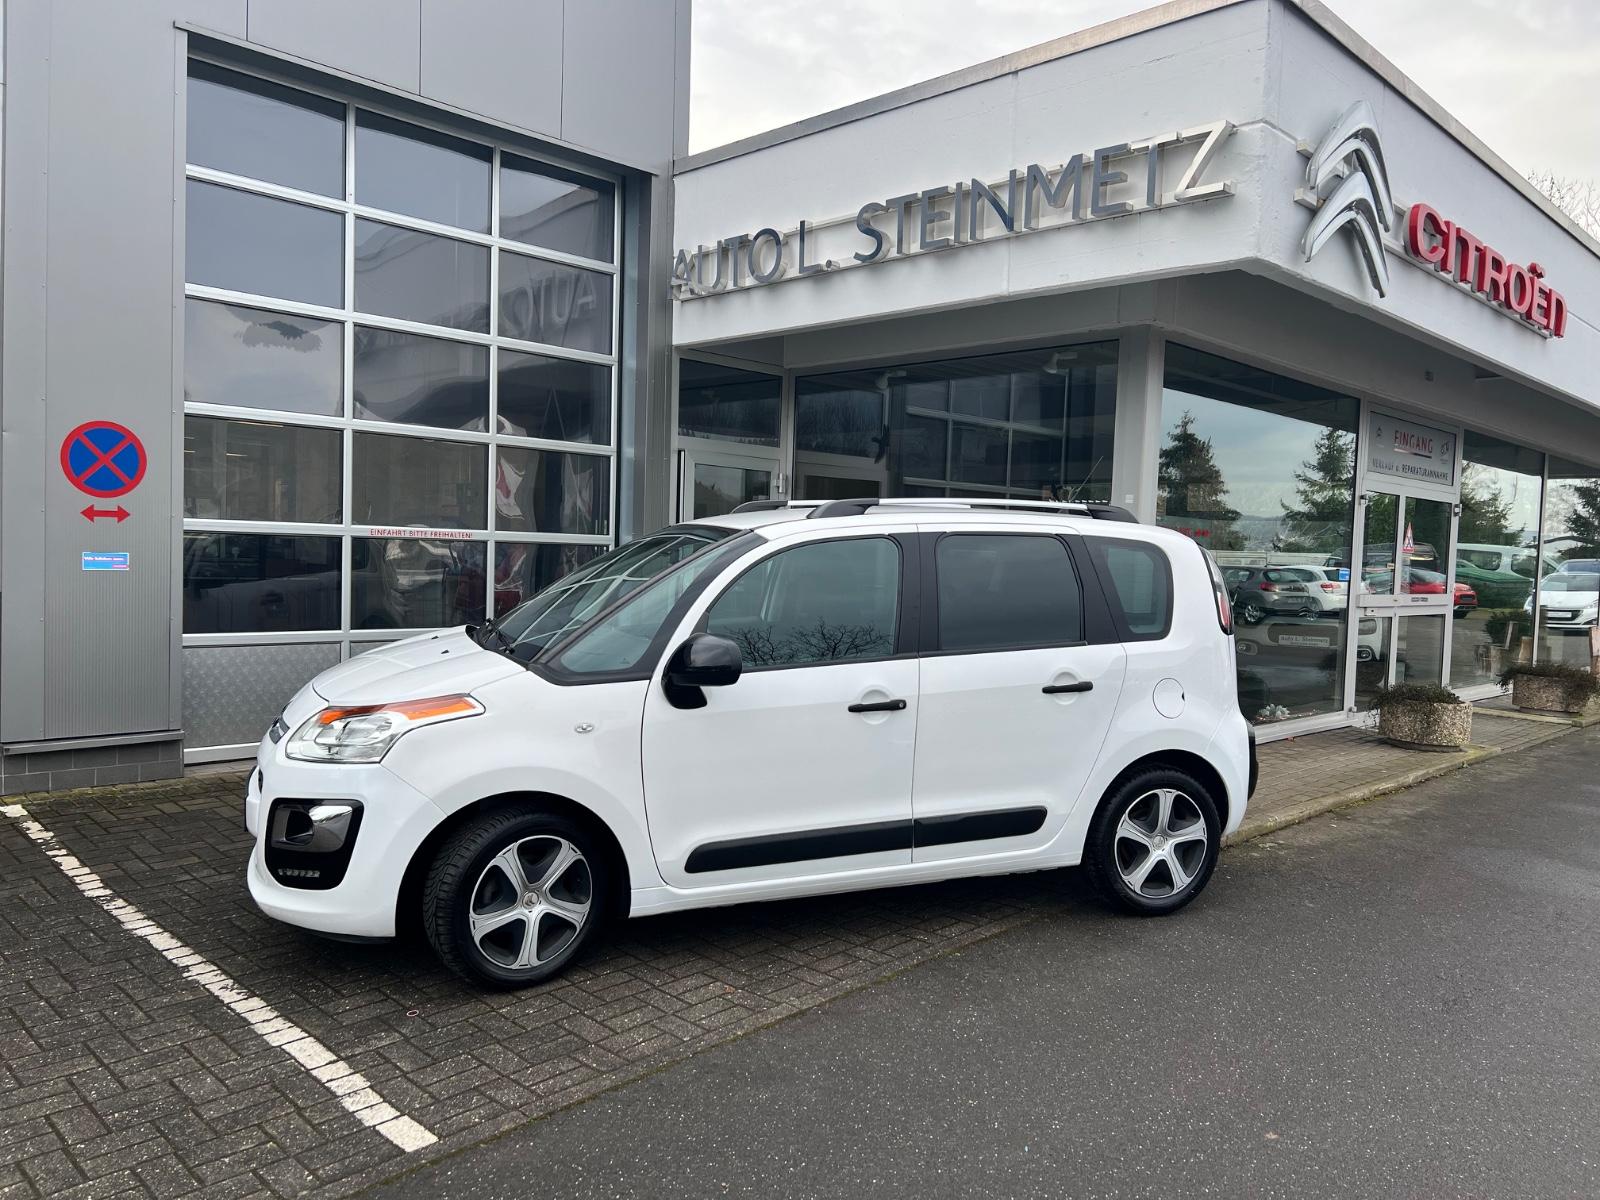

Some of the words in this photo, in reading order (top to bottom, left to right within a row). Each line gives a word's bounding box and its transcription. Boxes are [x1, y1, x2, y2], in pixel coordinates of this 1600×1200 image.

[669, 226, 788, 300] AUTO
[798, 219, 840, 275] L.
[852, 119, 1237, 266] STEINMETZ
[1404, 202, 1568, 339] CITROËN
[1394, 430, 1433, 454] EINGANG
[1402, 463, 1449, 481] REPARATURANNAHME
[370, 528, 407, 537] EINFAHRT
[409, 529, 428, 538] BITTE
[430, 531, 473, 539] FREIHALTEN!
